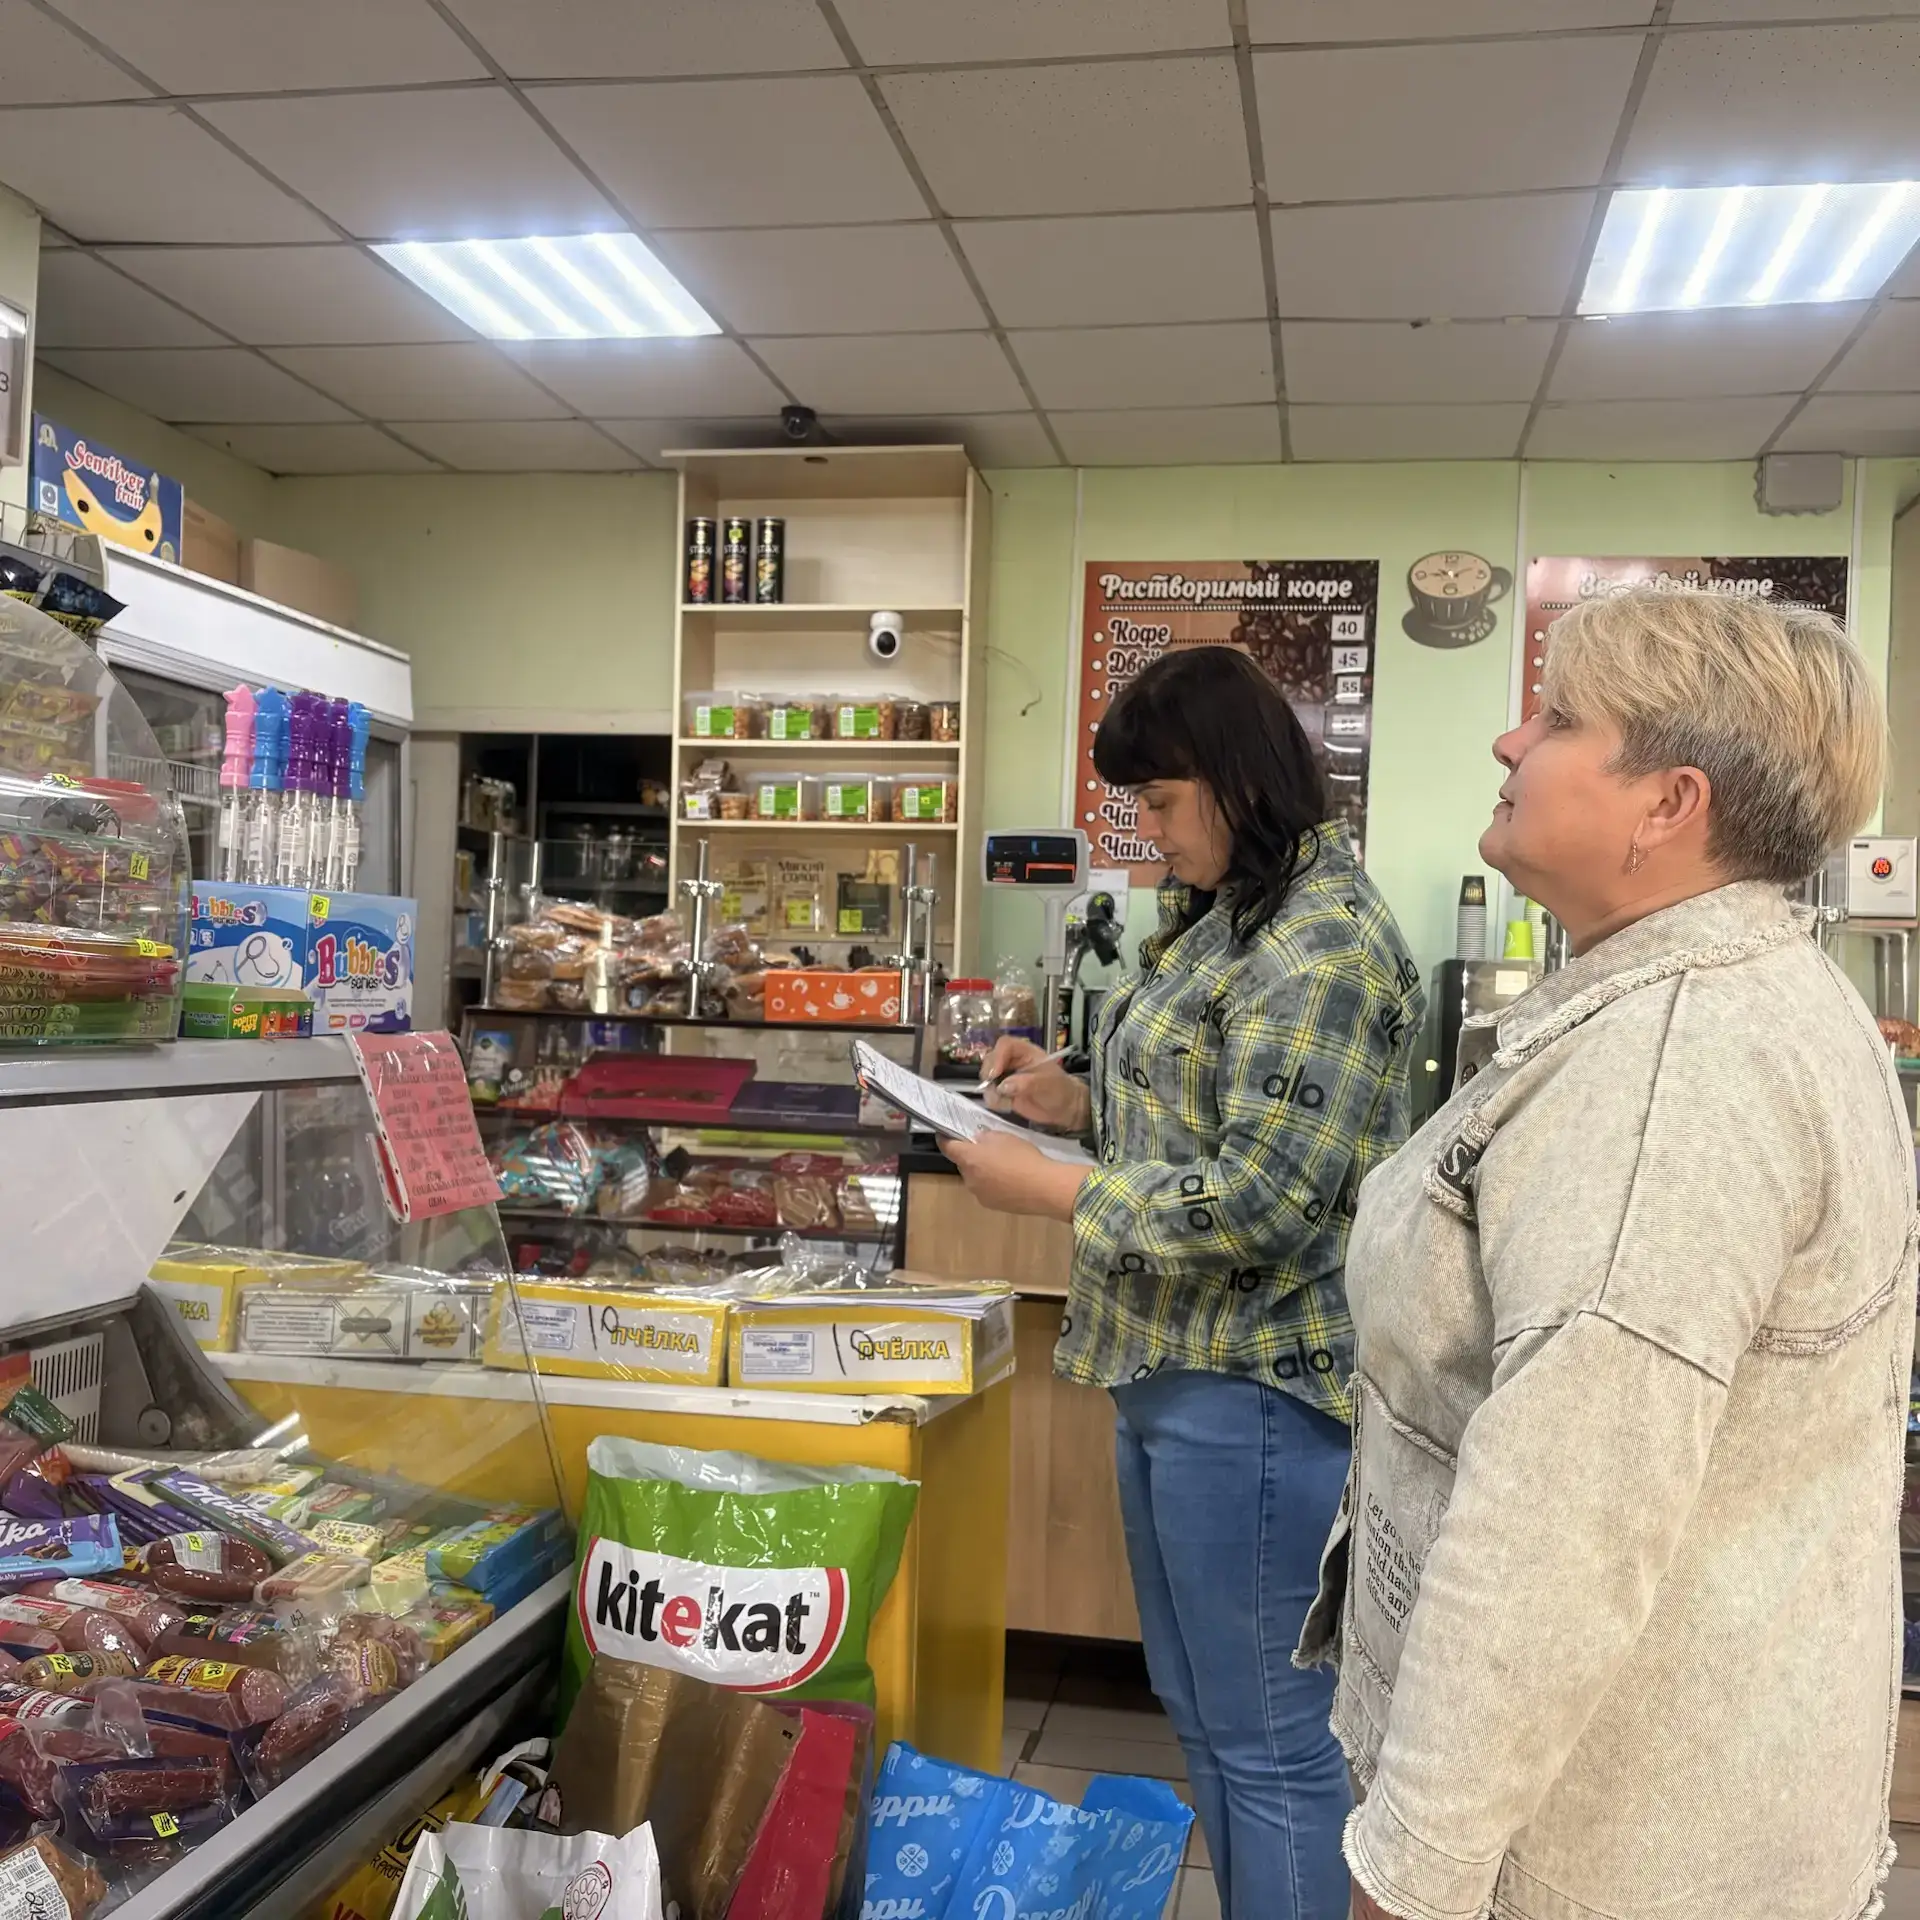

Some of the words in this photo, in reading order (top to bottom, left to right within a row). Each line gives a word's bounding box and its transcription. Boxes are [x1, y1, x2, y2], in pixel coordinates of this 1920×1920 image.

[1099, 573, 1280, 604] Растворимый
[1287, 577, 1353, 604] кофе
[1109, 618, 1171, 648] Кофе
[1337, 621, 1358, 636] 40
[1338, 652, 1358, 667] 45
[1342, 681, 1358, 694] 55
[317, 934, 401, 989] Bubbles
[1263, 1065, 1325, 1109] alo
[611, 1323, 700, 1355] ПЧЁЛКА
[858, 1334, 951, 1361] ПЧЁЛКА
[1273, 1336, 1335, 1380] alo
[177, 1481, 275, 1528] Milka
[1368, 1491, 1382, 1522] Let
[1383, 1517, 1397, 1538] go
[1387, 1568, 1412, 1602] have
[1393, 1555, 1412, 1585] that
[596, 1561, 810, 1655] kitekat
[1387, 1591, 1411, 1619] any
[870, 1793, 956, 1828] ерри
